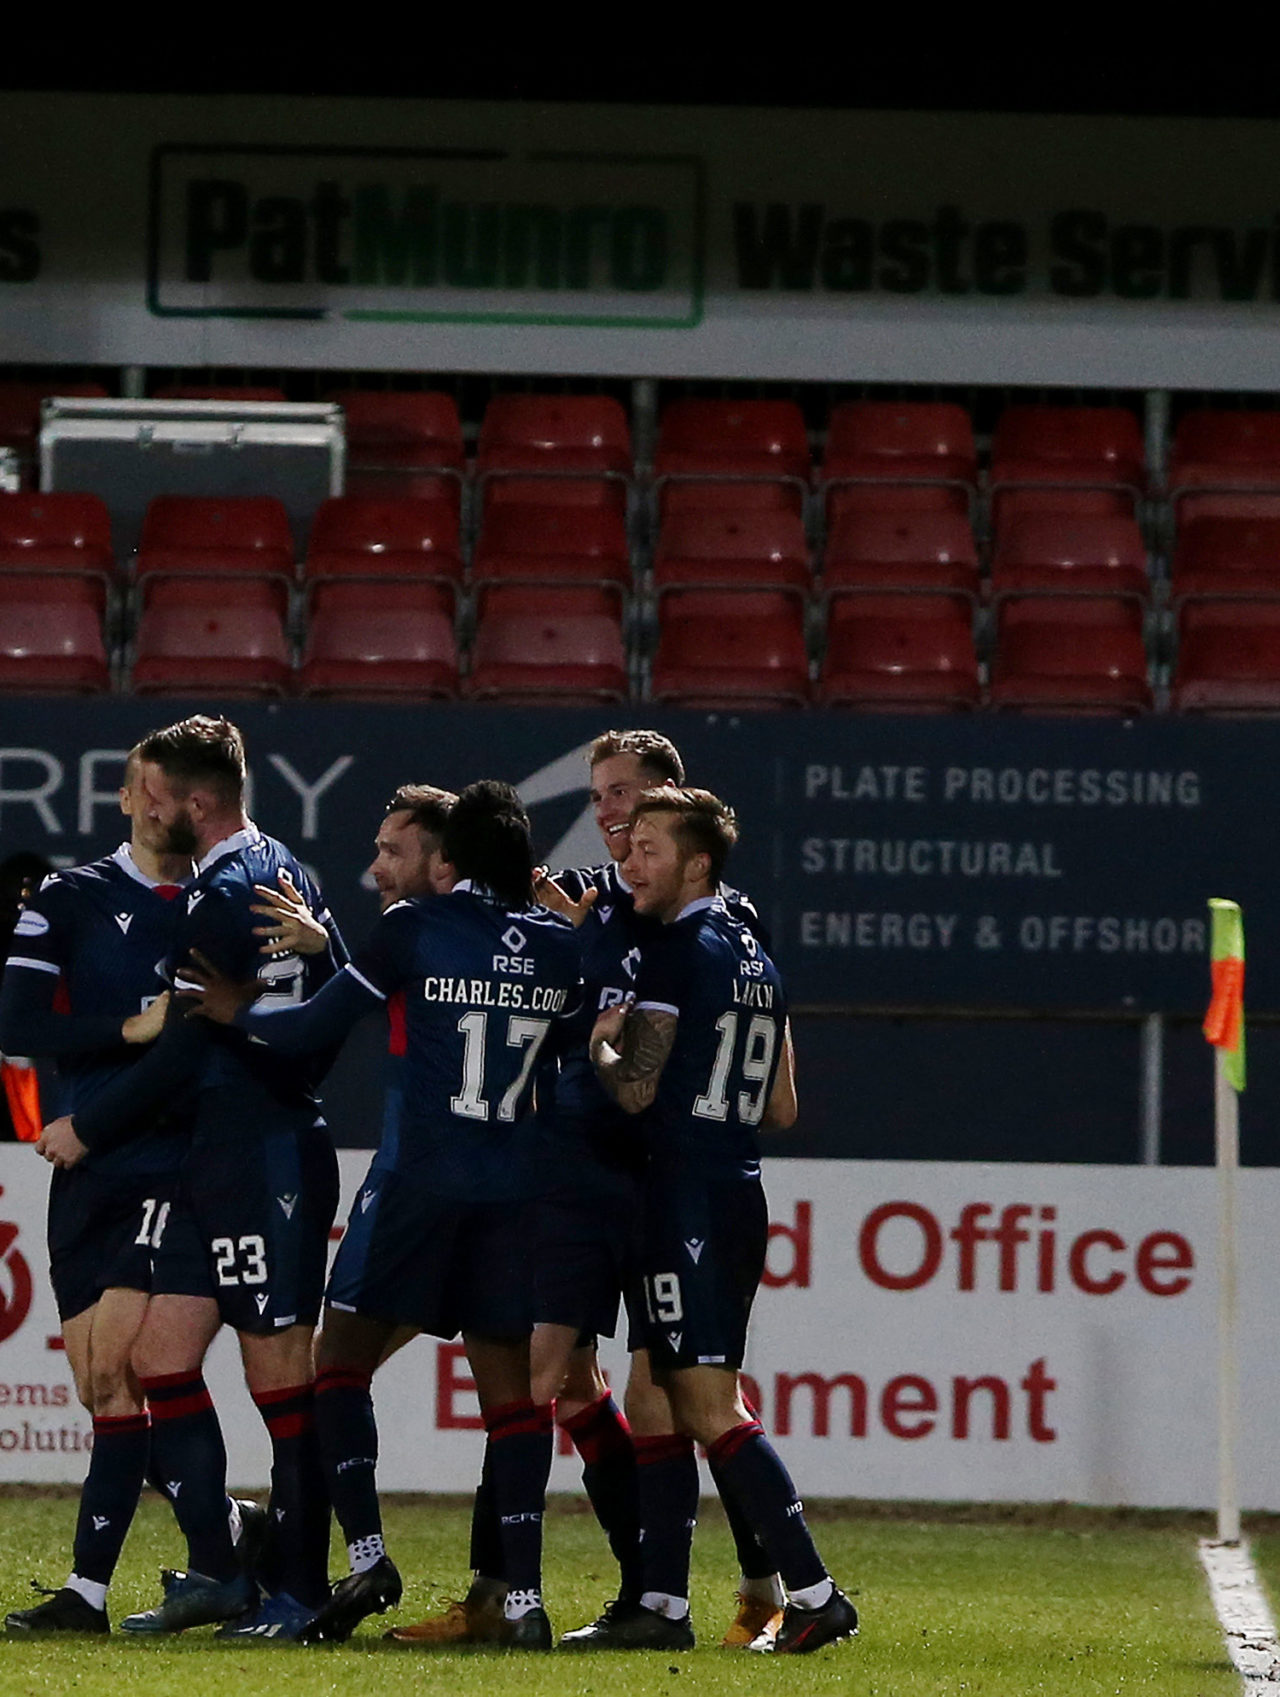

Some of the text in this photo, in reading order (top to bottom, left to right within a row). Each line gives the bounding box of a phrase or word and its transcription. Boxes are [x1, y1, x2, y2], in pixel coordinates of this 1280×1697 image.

[185, 178, 1280, 302] PatMunro Waste Serv
[804, 764, 1202, 806] PLATE PROCESSING
[801, 837, 1062, 877] STRUCTURAL
[800, 911, 1207, 954] ENERGY & OFFSHOR
[492, 955, 535, 976] RSE
[450, 1011, 552, 1122] 17
[691, 1010, 778, 1127] 19
[211, 1234, 268, 1287] 23
[860, 1202, 1195, 1297] Office
